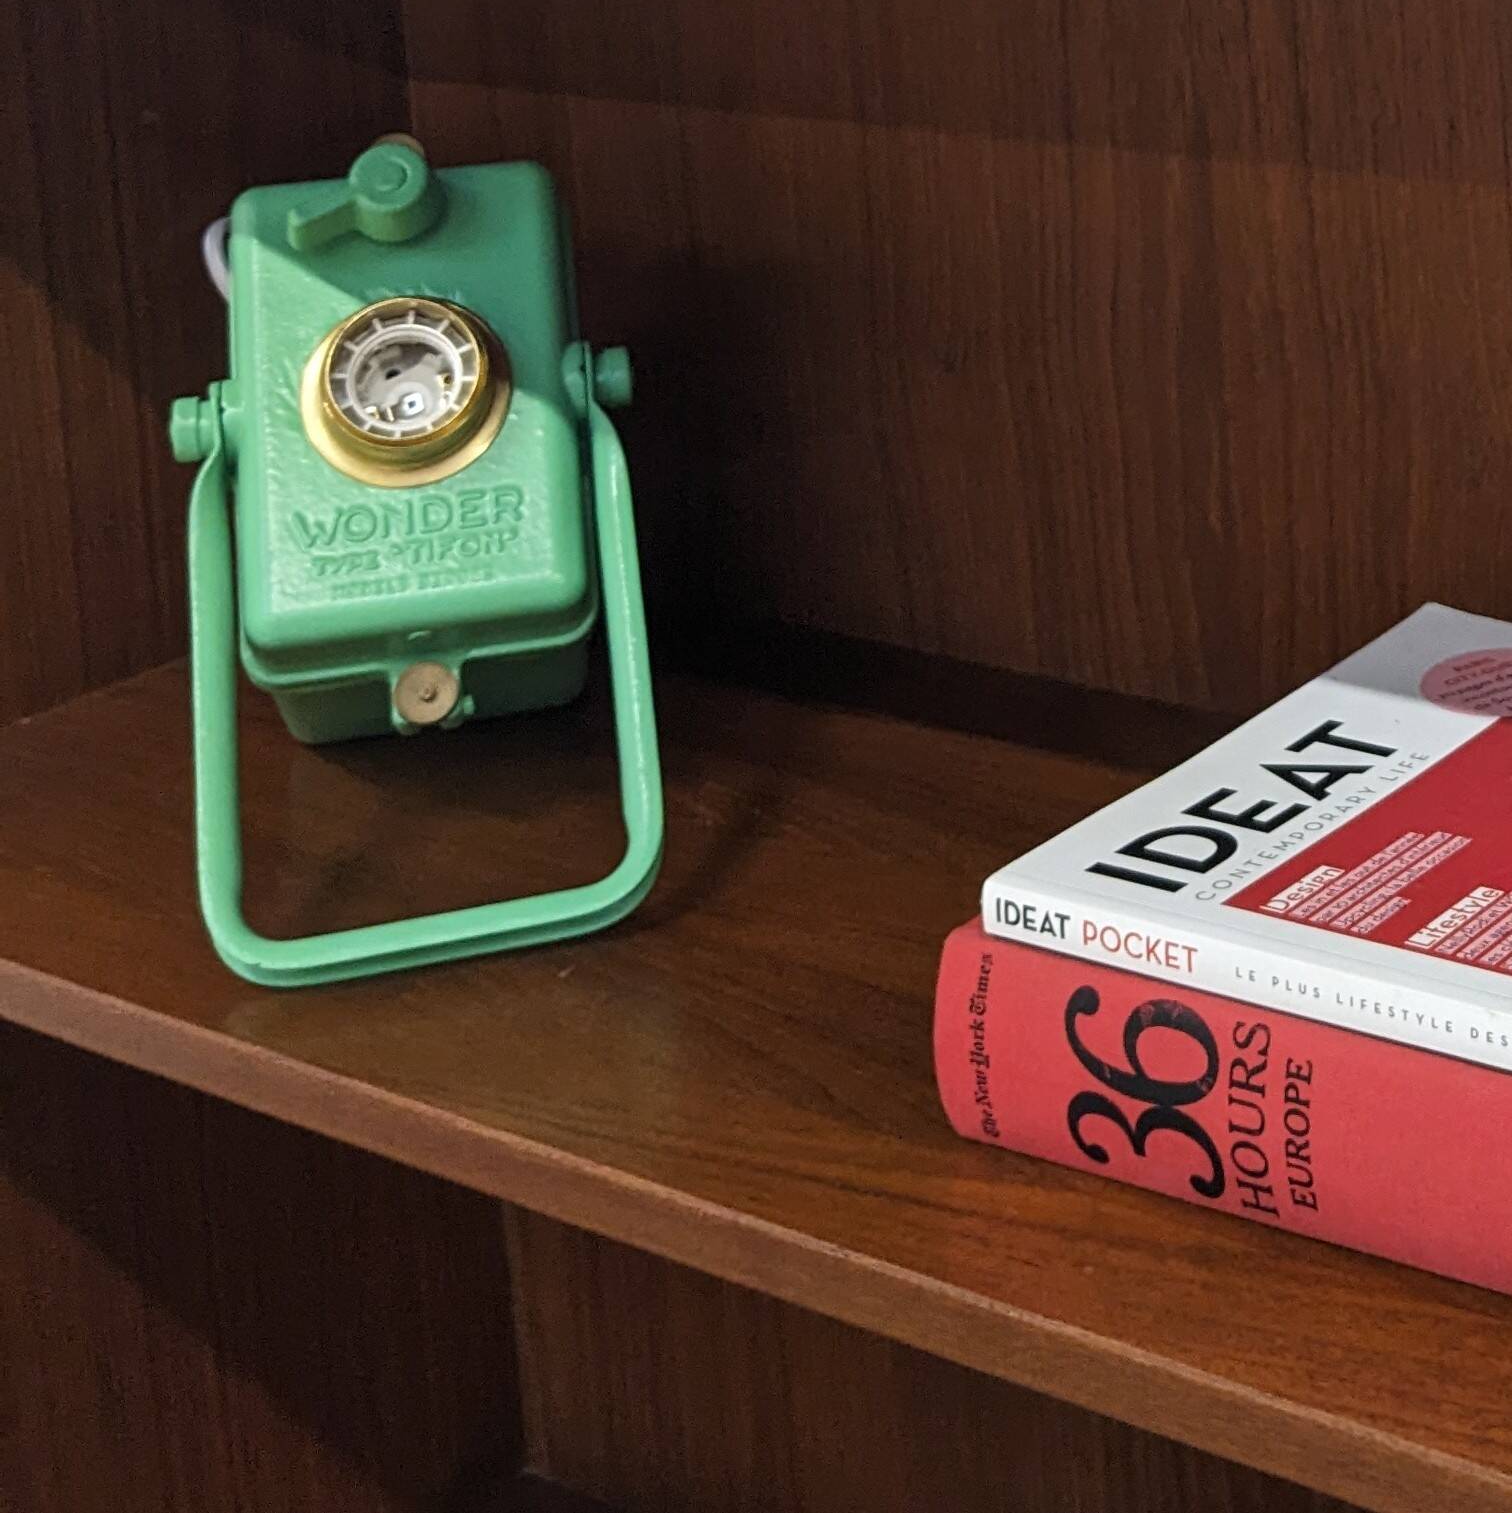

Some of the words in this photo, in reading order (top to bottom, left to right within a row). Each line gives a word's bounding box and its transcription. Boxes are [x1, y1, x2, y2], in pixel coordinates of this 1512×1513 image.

[292, 484, 524, 548] WONDER
[312, 549, 380, 576] TYPE
[1084, 719, 1398, 893] IDEAT
[1195, 785, 1377, 901] CONTEMPORARY
[1380, 751, 1431, 784] LIFE
[996, 897, 1070, 939] IDEAT
[1083, 919, 1198, 973] POCKET
[1406, 886, 1500, 946] Lifestyle
[969, 953, 993, 1016] Times
[1236, 967, 1256, 982] LE
[1272, 976, 1320, 998] PLUS
[1336, 992, 1453, 1033] LIFESTYLE
[1470, 1027, 1508, 1047] DES
[969, 1021, 990, 1072] York
[975, 1074, 991, 1107] New
[982, 1109, 1000, 1138] The
[1064, 985, 1225, 1198] 36
[1228, 1021, 1280, 1218] HOURS
[1283, 1057, 1319, 1211] EUROPE
